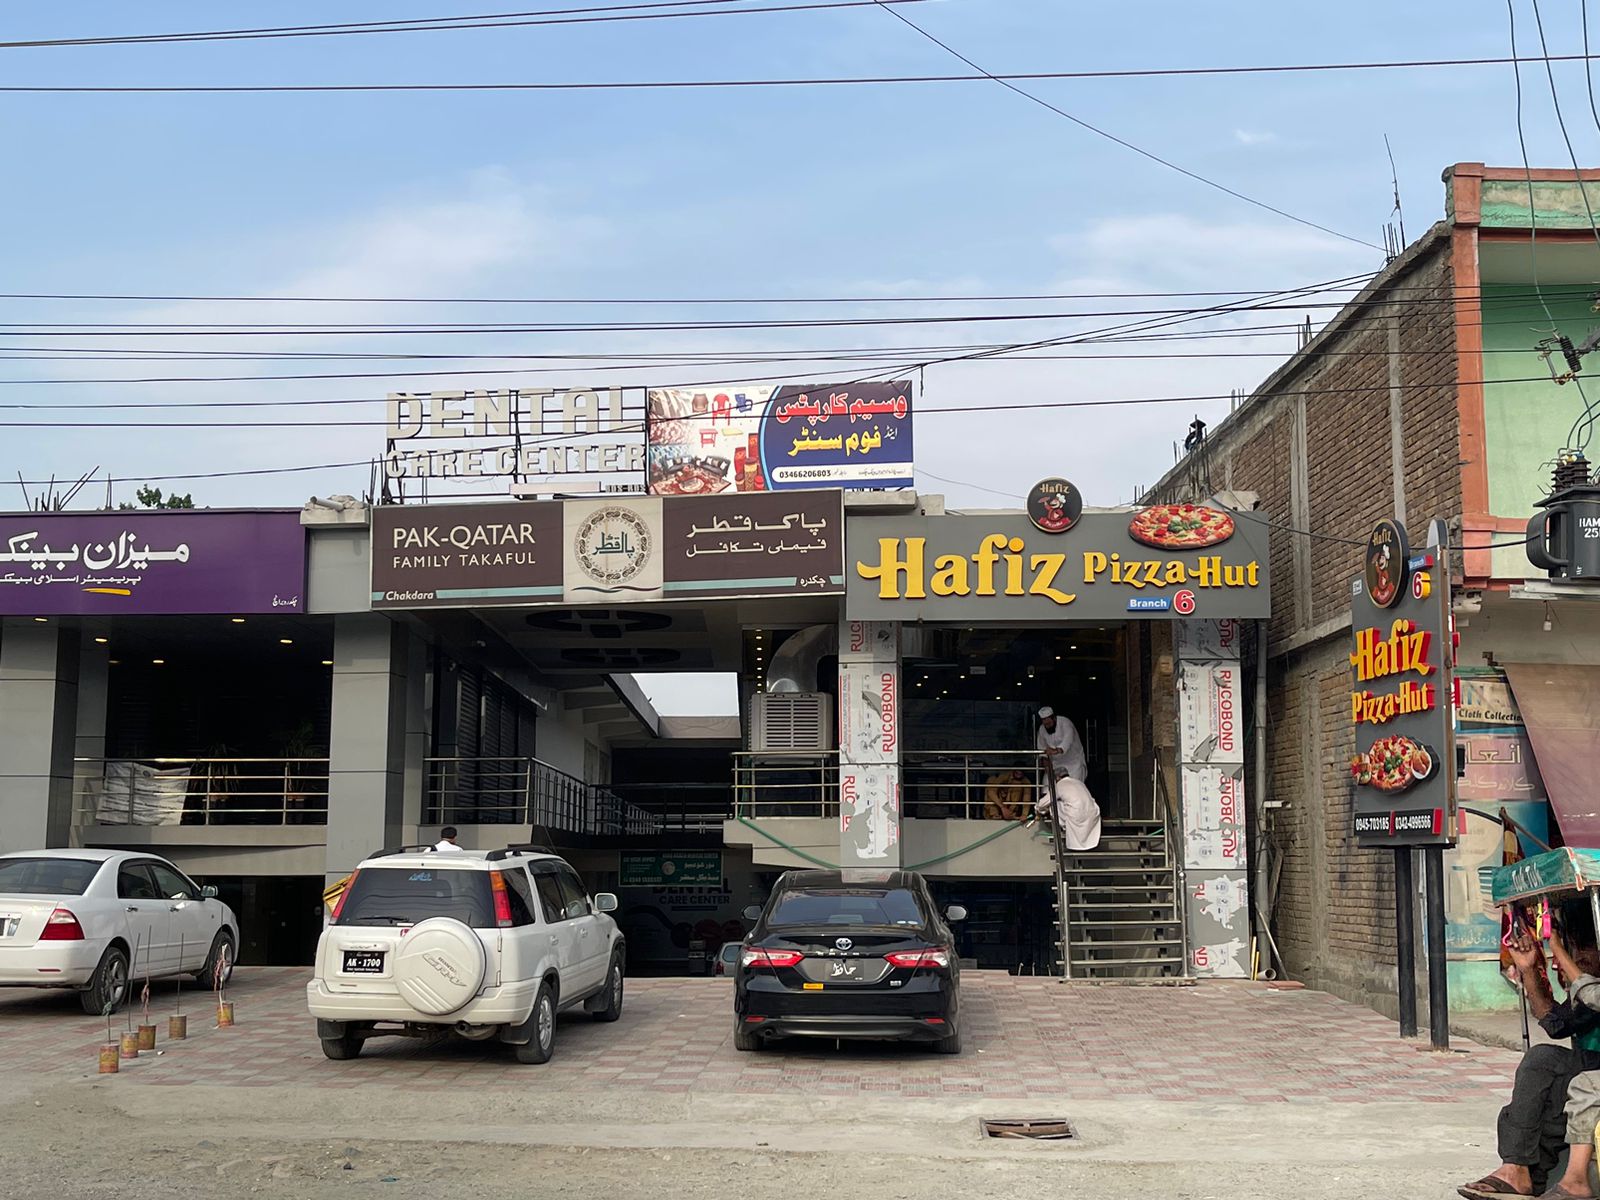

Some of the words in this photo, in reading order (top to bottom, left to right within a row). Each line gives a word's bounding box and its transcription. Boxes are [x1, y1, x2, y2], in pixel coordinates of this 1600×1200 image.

[387, 386, 644, 438] DENTAL
[850, 395, 907, 423] وسیم
[788, 426, 842, 456] سنٹر
[845, 425, 881, 456] فوم
[386, 449, 482, 478] CARE
[495, 444, 645, 476] CENTER
[780, 470, 831, 478] 03466206803
[1040, 483, 1070, 493] Hafiz
[393, 523, 536, 550] PAK-QATAR
[686, 515, 752, 538] قطر
[754, 513, 826, 536] پاک
[0, 531, 79, 571] بینک
[84, 530, 189, 570] میزان
[686, 541, 764, 558] تکافل
[767, 537, 826, 554] فیملی
[393, 555, 451, 569] FAMILY
[459, 552, 536, 567] TAKAFUL
[857, 534, 1076, 604] Hafiz
[1083, 552, 1188, 588] Pizza
[386, 590, 434, 600] Chakdara
[1413, 571, 1425, 599] 6
[1130, 599, 1167, 609] Branch
[1173, 590, 1196, 615] 6
[1350, 619, 1432, 682] Hafiz
[881, 673, 895, 752] RUCOBOND
[1351, 690, 1394, 725] Pizza
[1393, 682, 1431, 715] Hut
[1459, 709, 1482, 719] Cloth
[659, 896, 687, 904] CARE
[690, 895, 730, 904] CENTER
[363, 958, 381, 967] 1700
